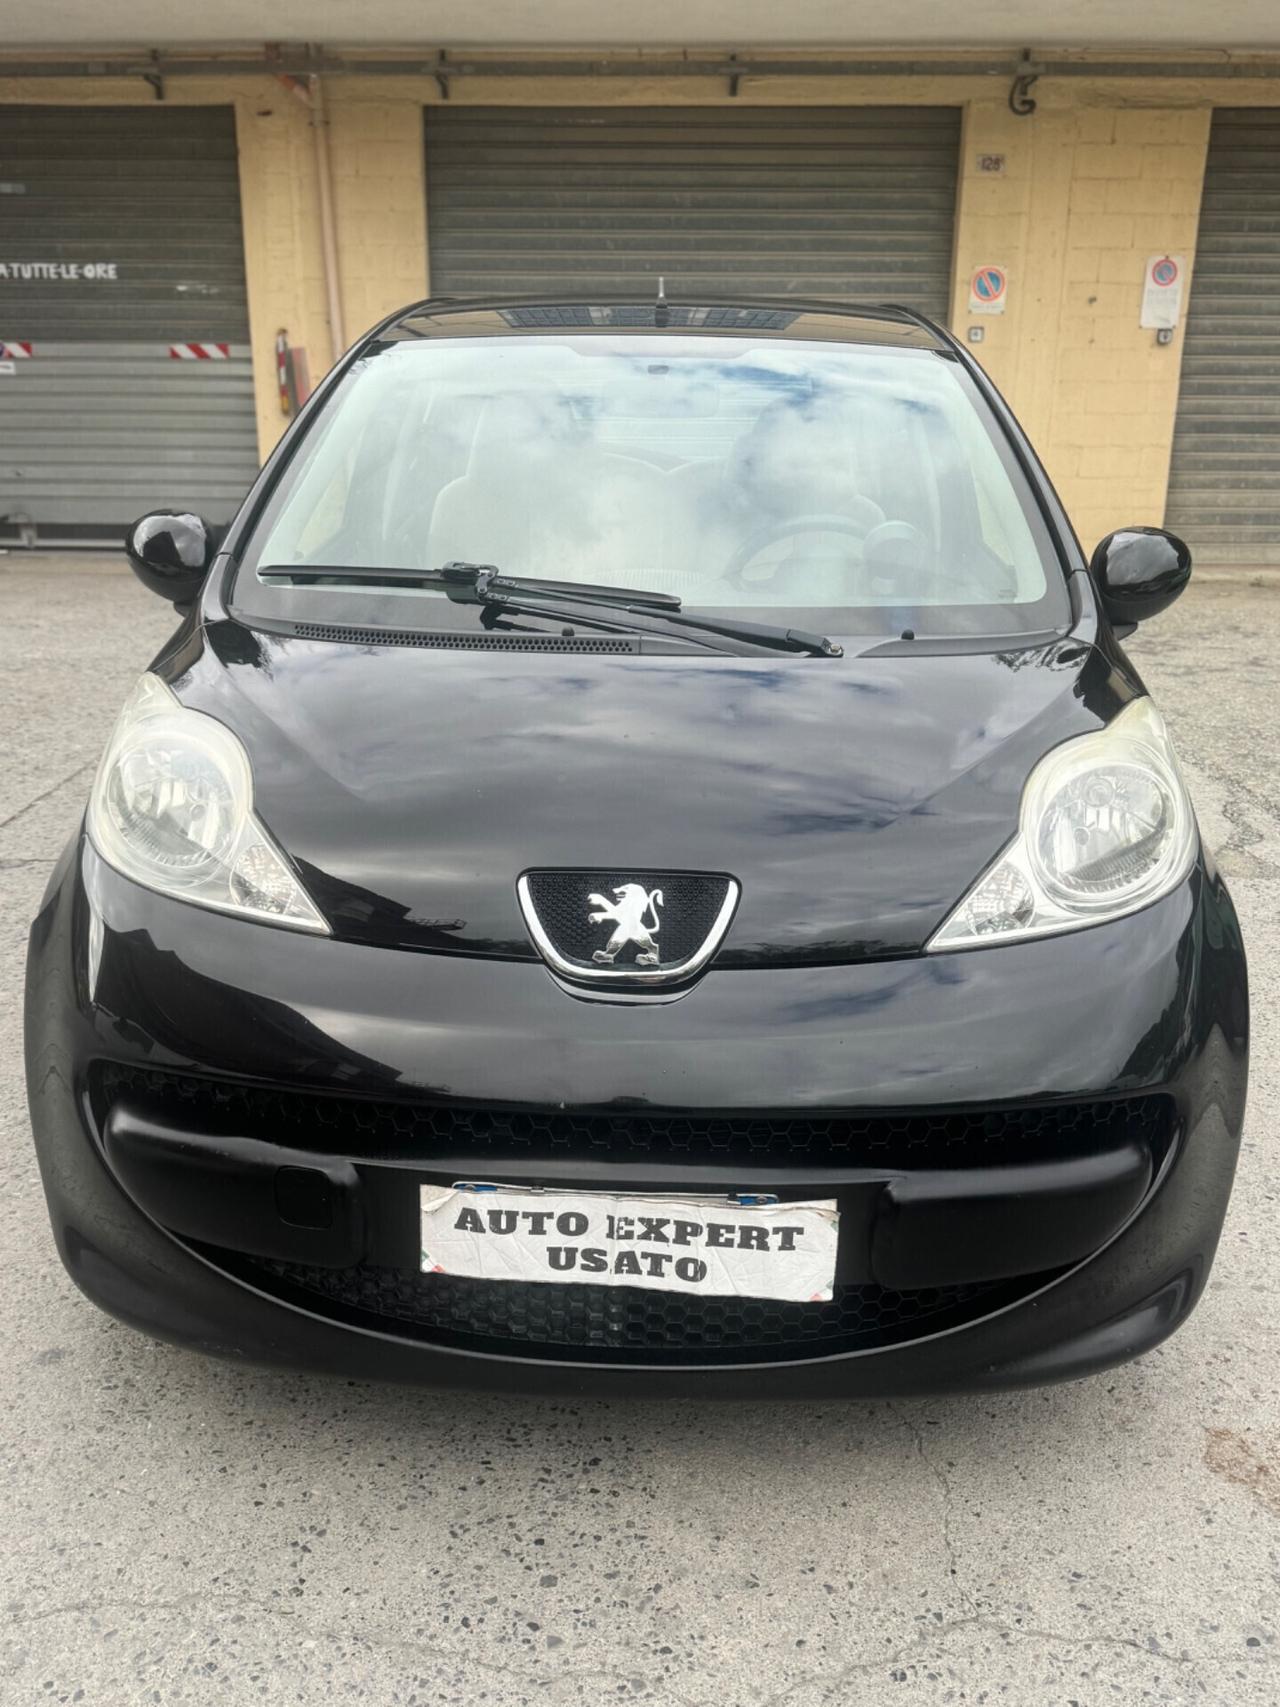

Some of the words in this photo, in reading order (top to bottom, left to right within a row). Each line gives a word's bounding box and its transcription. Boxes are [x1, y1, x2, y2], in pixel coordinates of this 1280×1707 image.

[454, 1207, 589, 1236] AUTO
[606, 1214, 804, 1252] EXPERT
[546, 1247, 707, 1282] USATO
